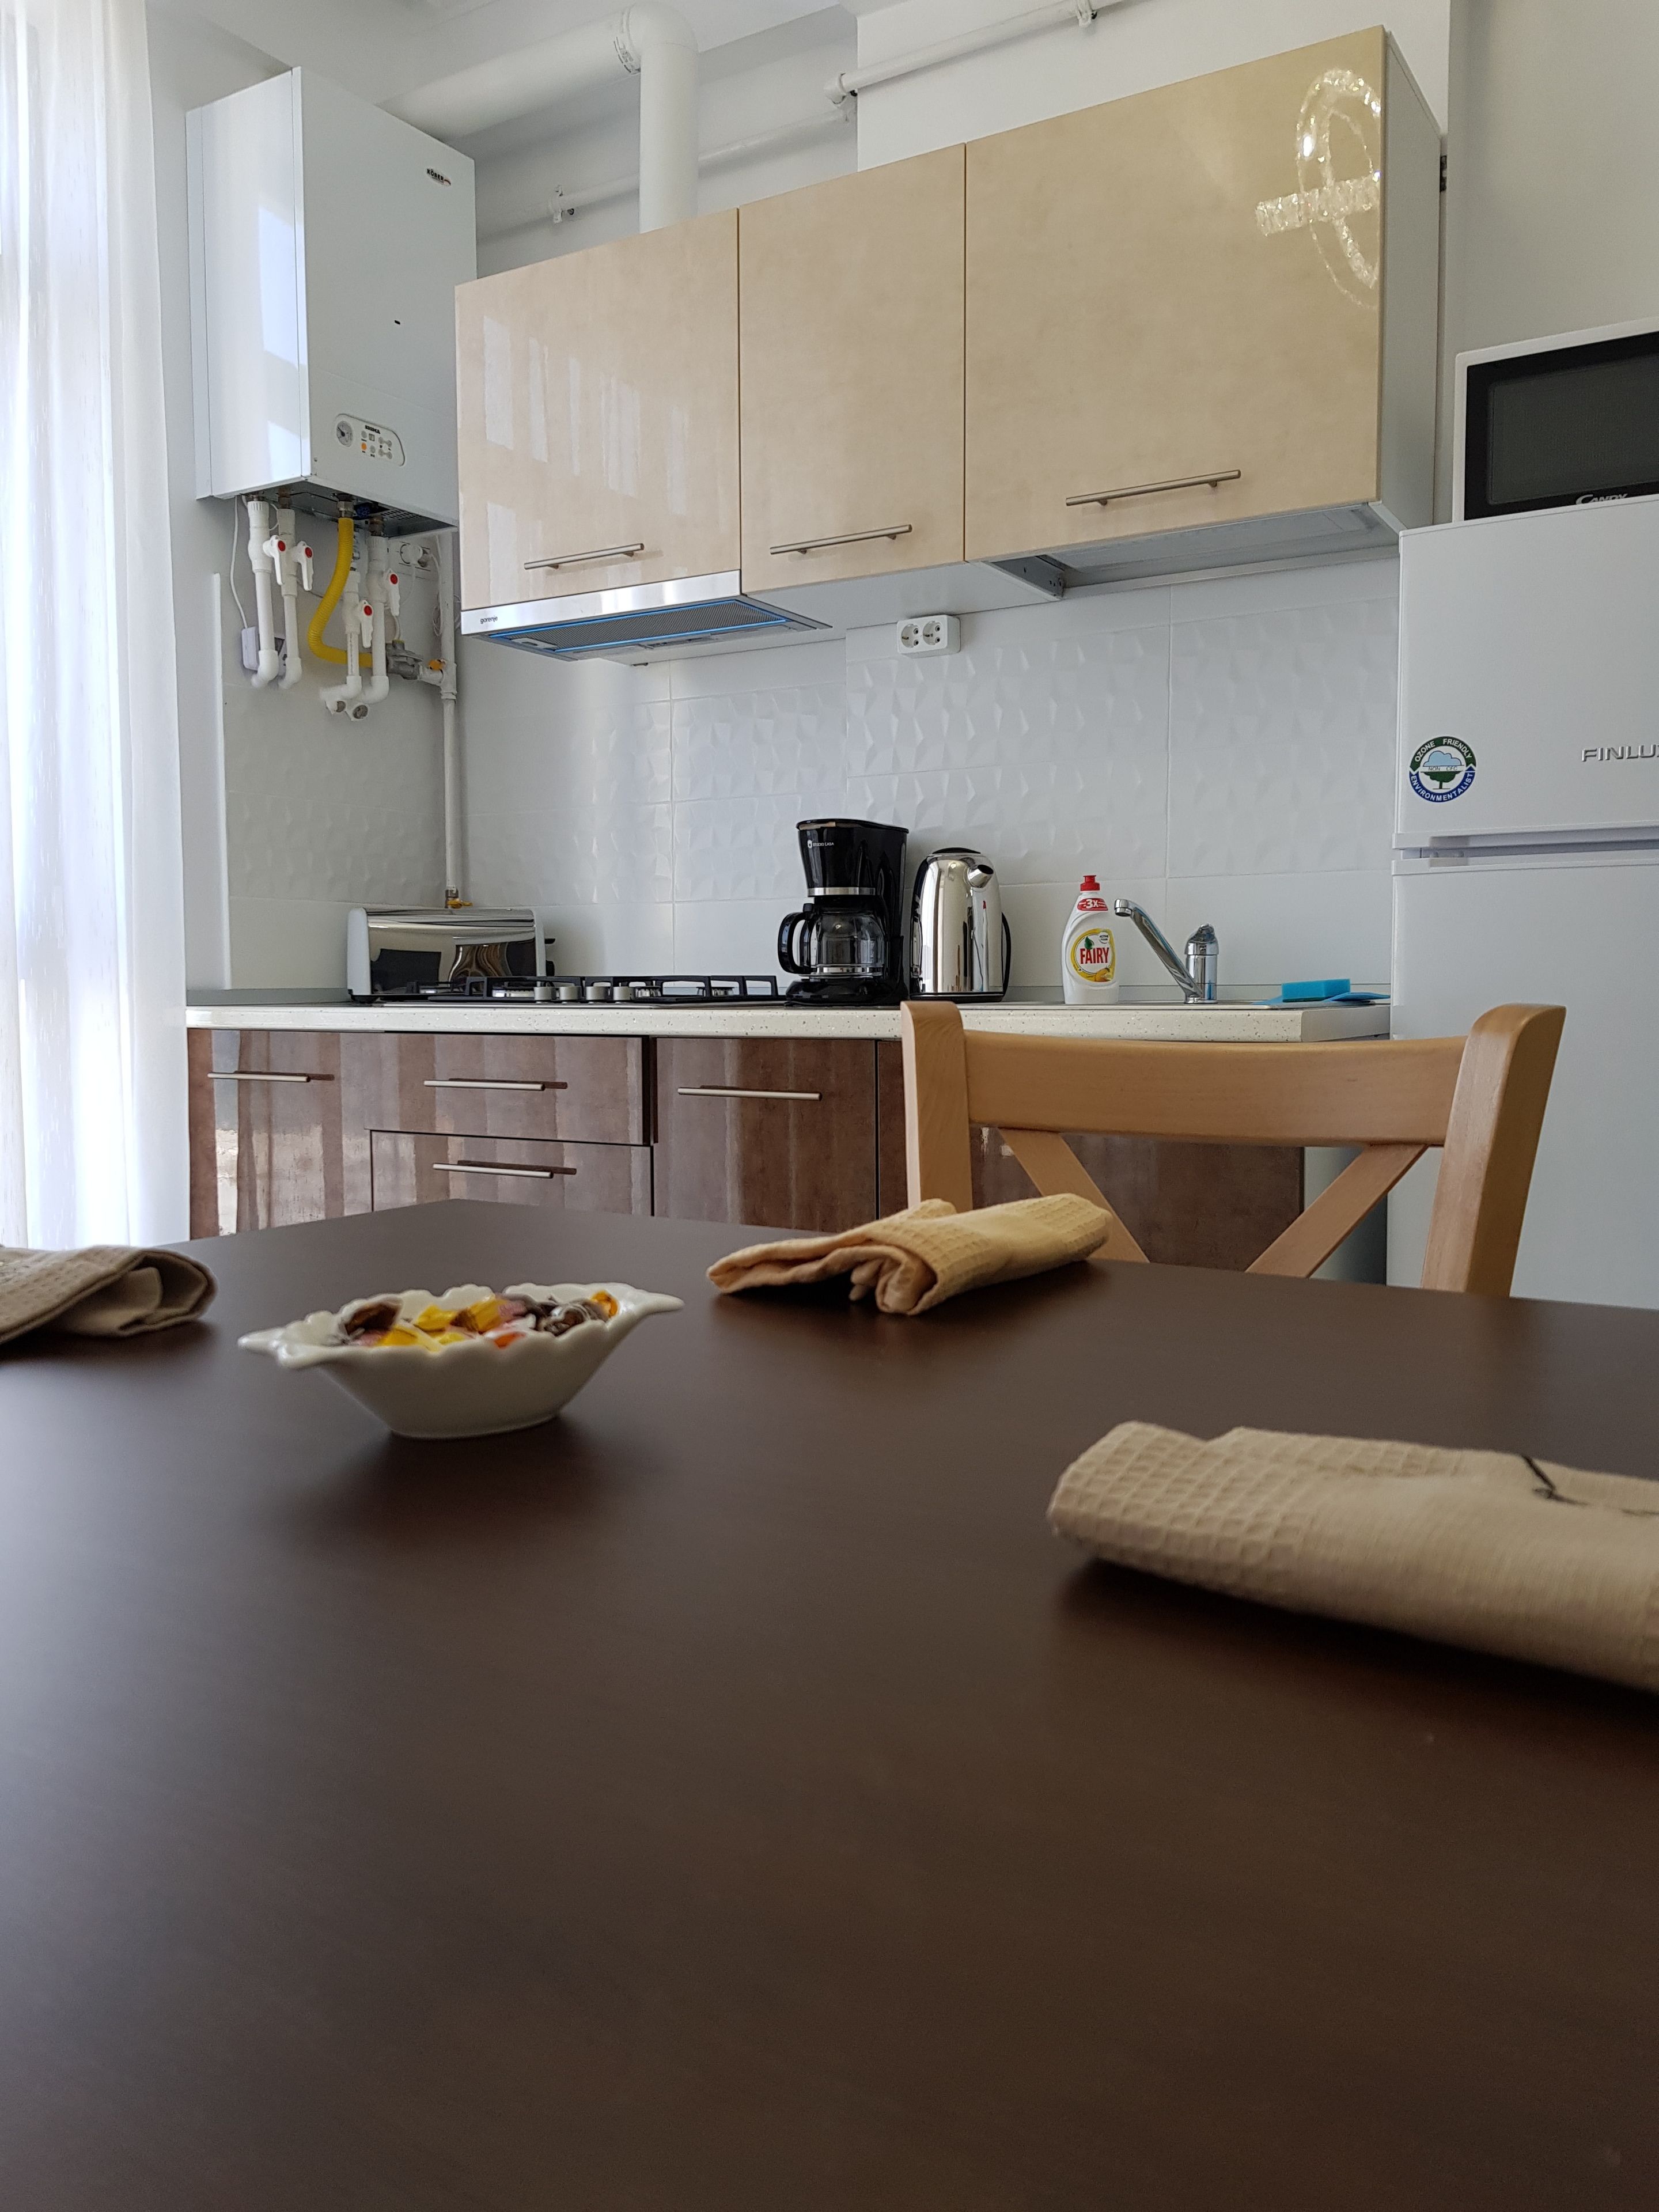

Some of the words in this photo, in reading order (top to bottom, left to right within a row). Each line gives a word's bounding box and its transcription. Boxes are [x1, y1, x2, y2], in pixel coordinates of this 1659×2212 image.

[1415, 741, 1435, 762] OZONE
[1442, 738, 1472, 759] FRIENDLY
[1581, 744, 1659, 762] FINLU
[1411, 773, 1473, 801] ENVIRONMENTALIST
[1080, 947, 1109, 964] FAIRY
